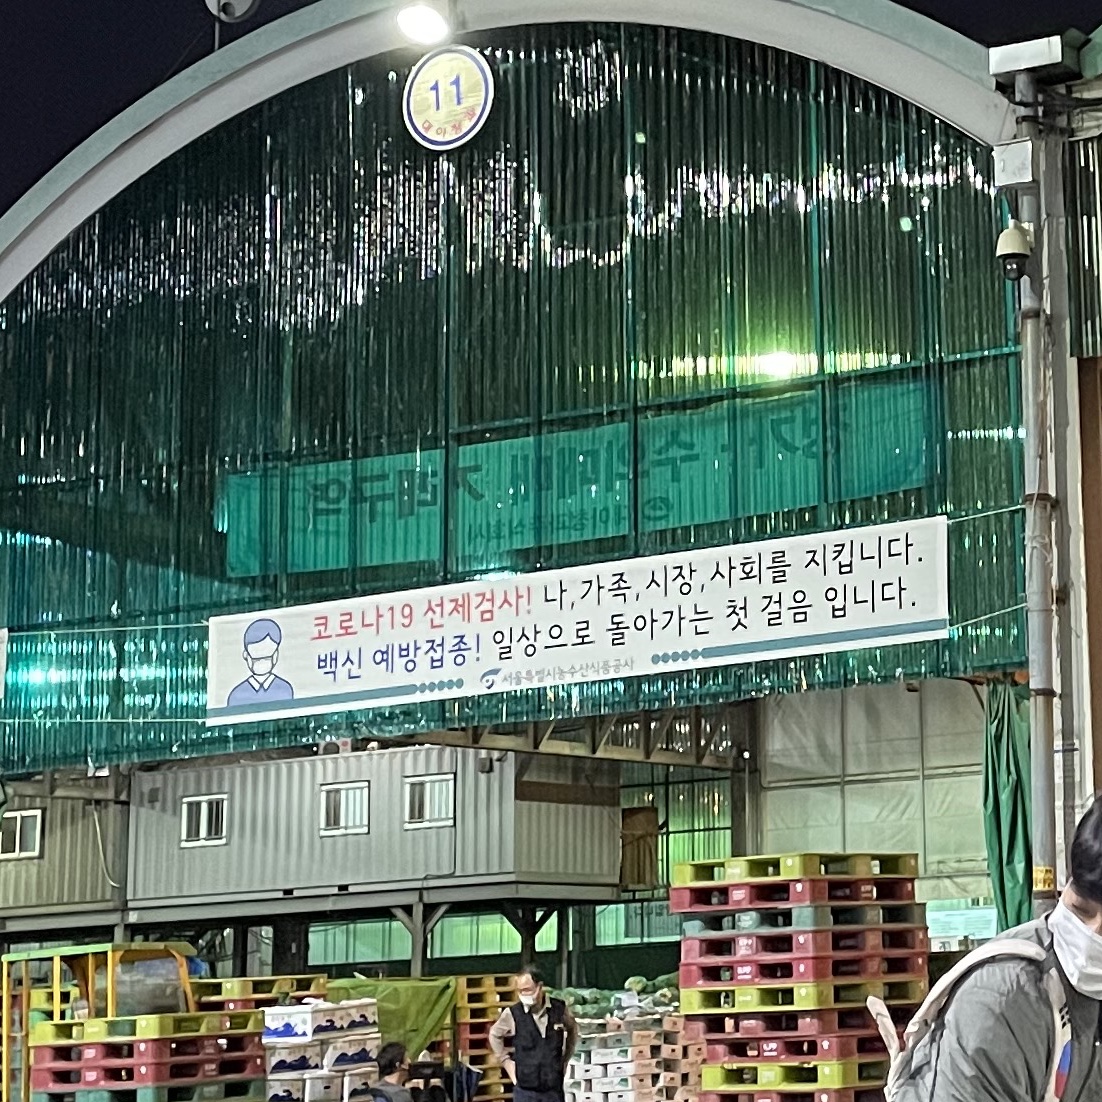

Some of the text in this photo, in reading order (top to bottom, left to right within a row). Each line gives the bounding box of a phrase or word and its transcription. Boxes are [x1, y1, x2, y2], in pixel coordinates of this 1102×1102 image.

[429, 74, 463, 112] 11
[310, 603, 413, 641] 코로나19
[423, 586, 532, 629] 선제검사!
[804, 532, 924, 577] 지킵니다.
[317, 576, 918, 683] 백신 예방접종! 일상으로 돌아가는 첫 걸음 입니다.
[501, 657, 635, 686] 서울특별시농수산식품공사
